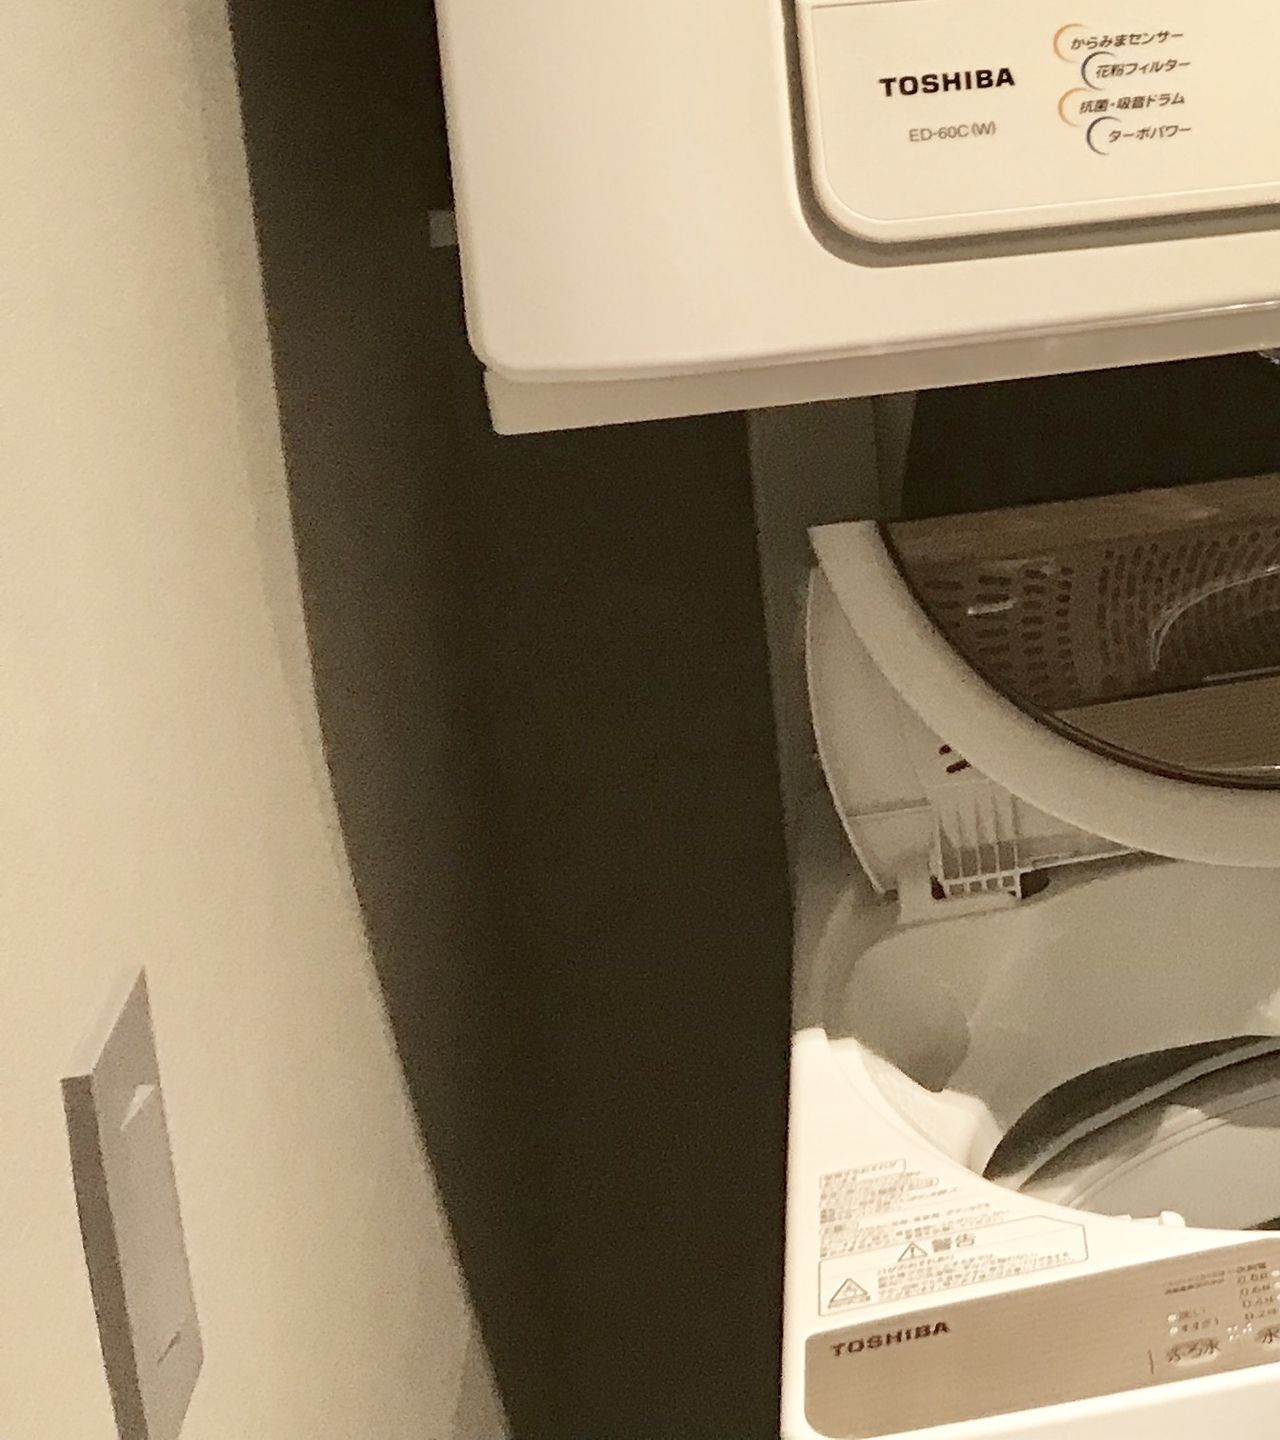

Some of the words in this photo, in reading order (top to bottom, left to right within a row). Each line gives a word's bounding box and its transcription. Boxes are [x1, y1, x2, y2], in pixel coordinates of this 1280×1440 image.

[1070, 30, 1185, 51] からみまセンサー
[1095, 58, 1192, 80] 花粉フィルター
[879, 66, 1016, 98] TOSHIBA
[1079, 92, 1186, 116] 抗菌・吸音ドラム
[1108, 123, 1193, 144] ターボパワー
[830, 1321, 951, 1357] TOSHIBA
